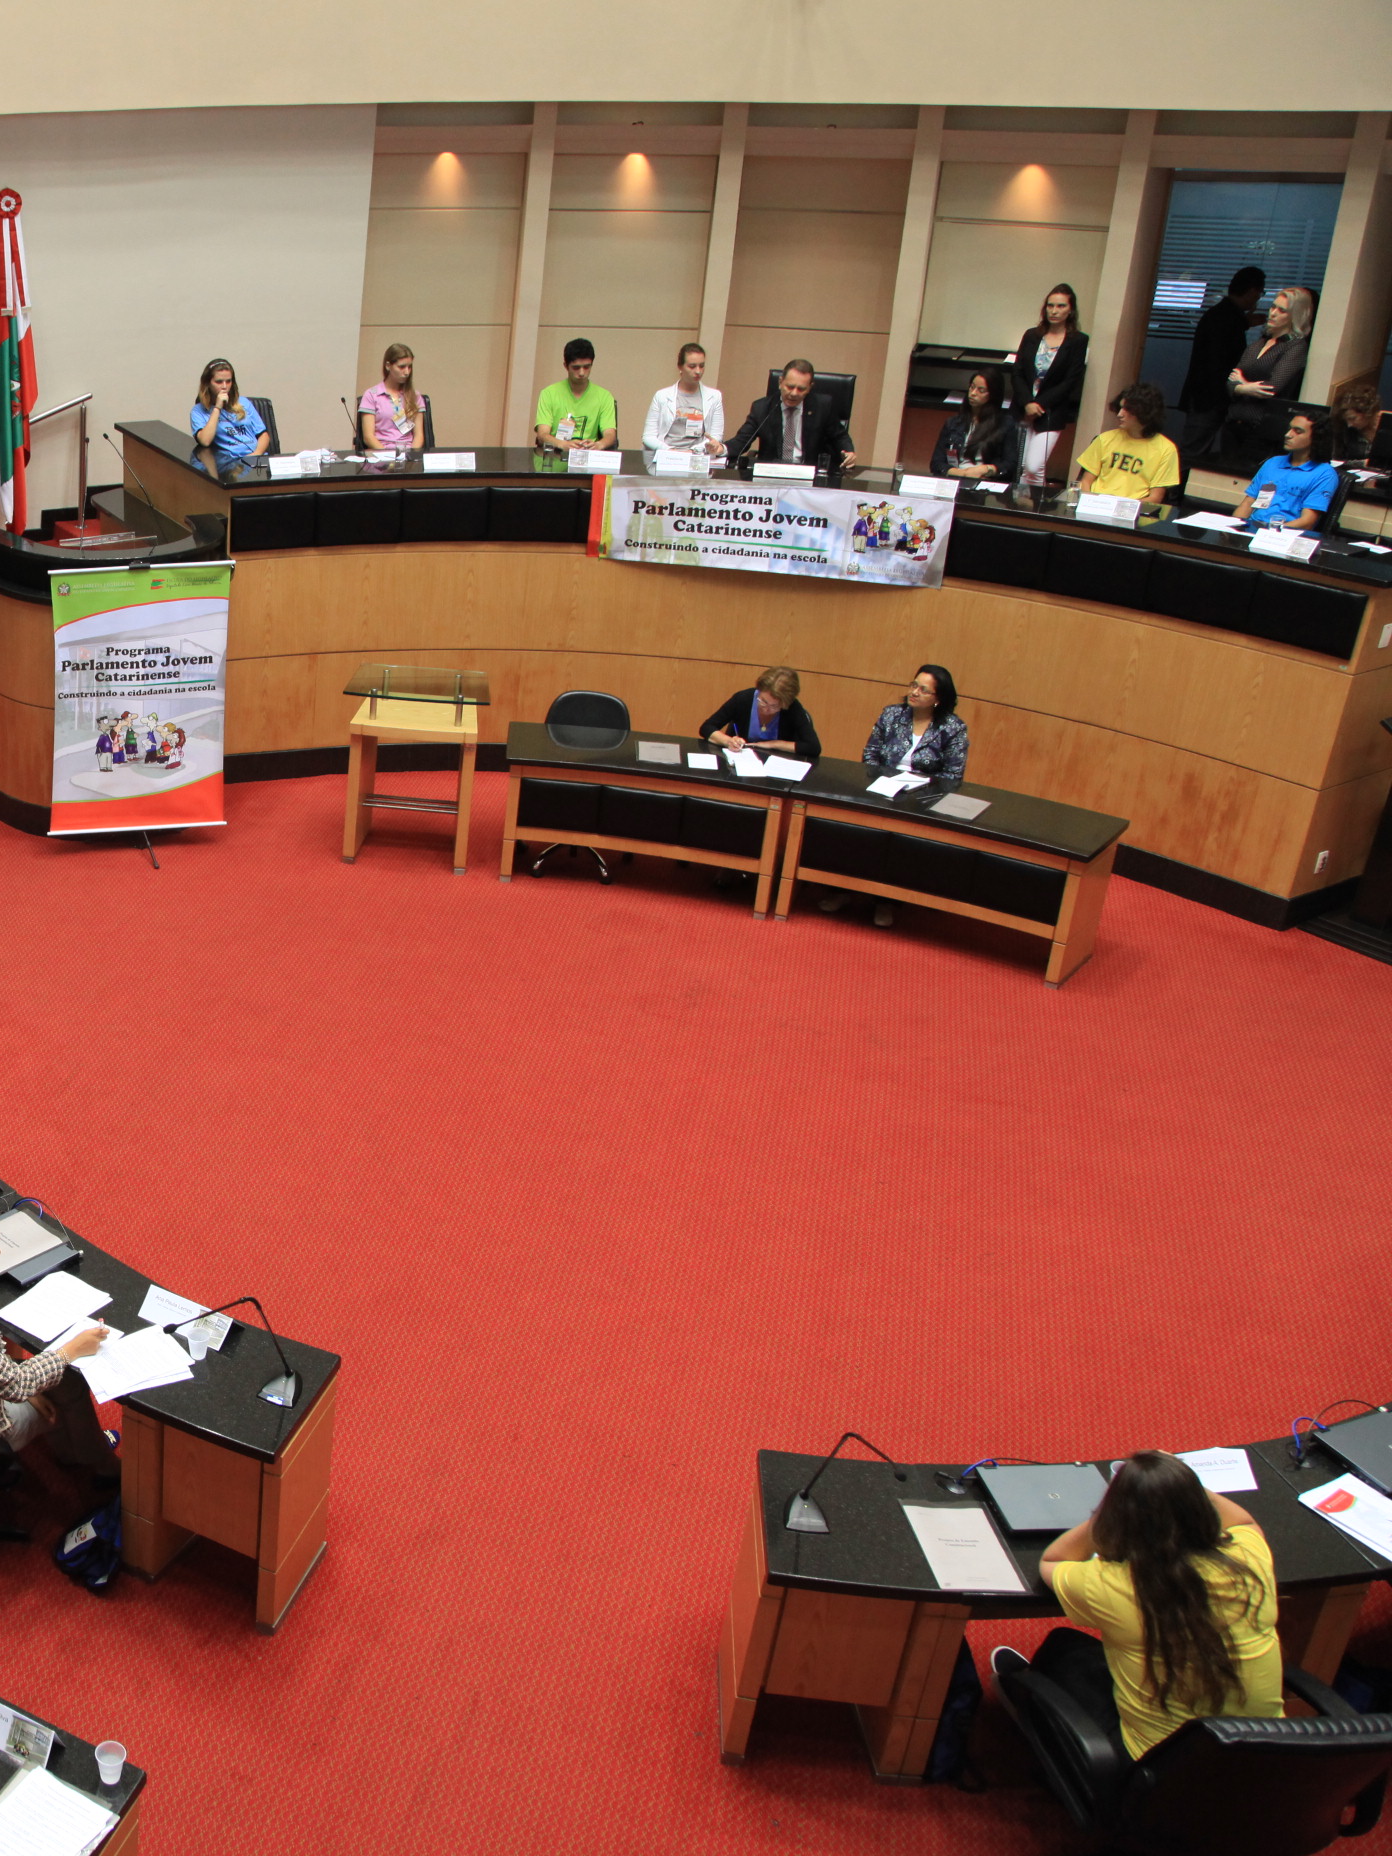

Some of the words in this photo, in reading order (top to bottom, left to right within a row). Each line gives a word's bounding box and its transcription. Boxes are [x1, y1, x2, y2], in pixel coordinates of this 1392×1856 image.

[690, 489, 773, 506] Programa
[632, 500, 753, 522] Parlamento
[759, 509, 828, 528] Jovem
[673, 520, 782, 540] Catarinense
[624, 538, 699, 553] Construindo
[712, 546, 770, 558] cidadania
[773, 552, 788, 560] na
[791, 554, 828, 564] escola
[106, 646, 170, 658] Programa
[62, 658, 157, 672] Parlamento
[161, 655, 213, 667] Jovem
[95, 670, 180, 682] Catarinense
[58, 689, 118, 699] Construindo
[128, 687, 172, 696] cidadania
[188, 684, 216, 692] escola
[155, 1295, 164, 1303] Ana
[165, 1299, 177, 1308] Paula
